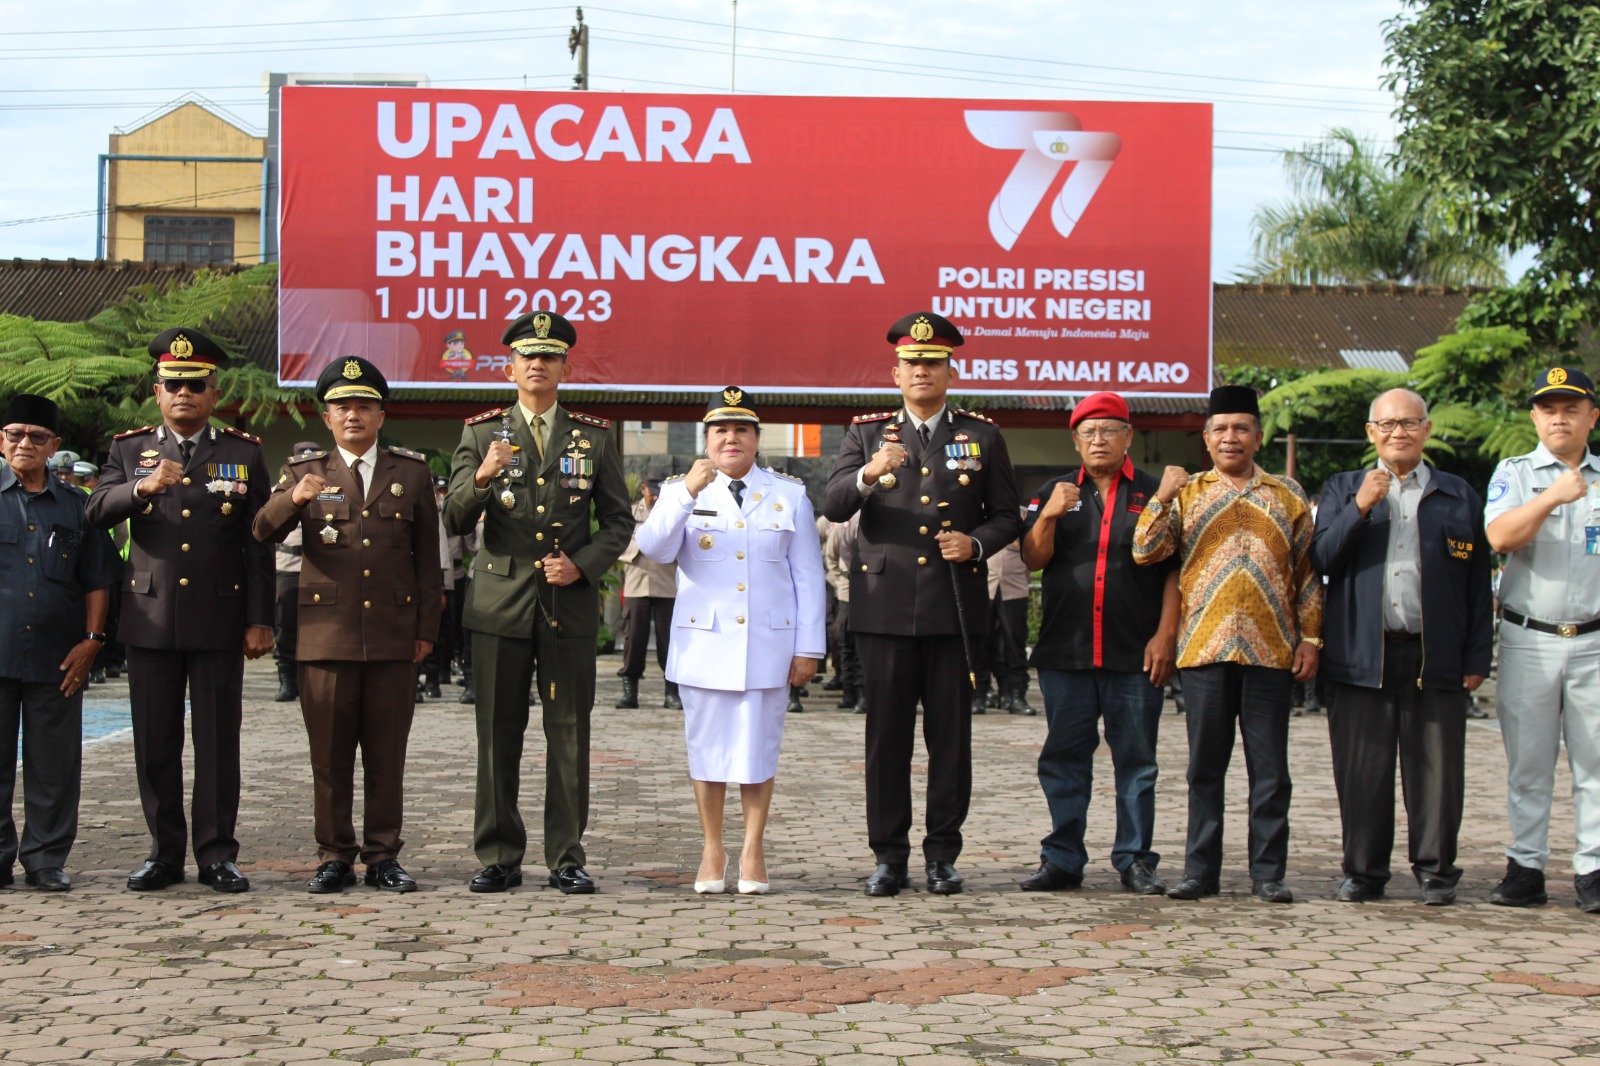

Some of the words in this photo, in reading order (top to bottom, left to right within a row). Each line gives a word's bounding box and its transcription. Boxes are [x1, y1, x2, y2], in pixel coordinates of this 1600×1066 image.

[377, 101, 752, 164] UPACARA
[376, 174, 534, 224] HARI
[376, 230, 886, 285] BHAYANGKARA
[938, 267, 1025, 290] POLRI
[1034, 269, 1146, 292] PRESISI
[375, 286, 390, 319] 1
[406, 287, 488, 320] JULI
[504, 288, 612, 322] 2023
[931, 296, 1037, 319] UNTUK
[1045, 298, 1152, 321] NEGERI
[973, 326, 1013, 338] Damai
[1014, 327, 1059, 341] Menuju
[1060, 327, 1118, 340] Indonesia
[1119, 328, 1151, 342] Maju
[949, 359, 1019, 381] LRES
[1024, 360, 1111, 382] TANAH
[1117, 361, 1190, 384] KARO
